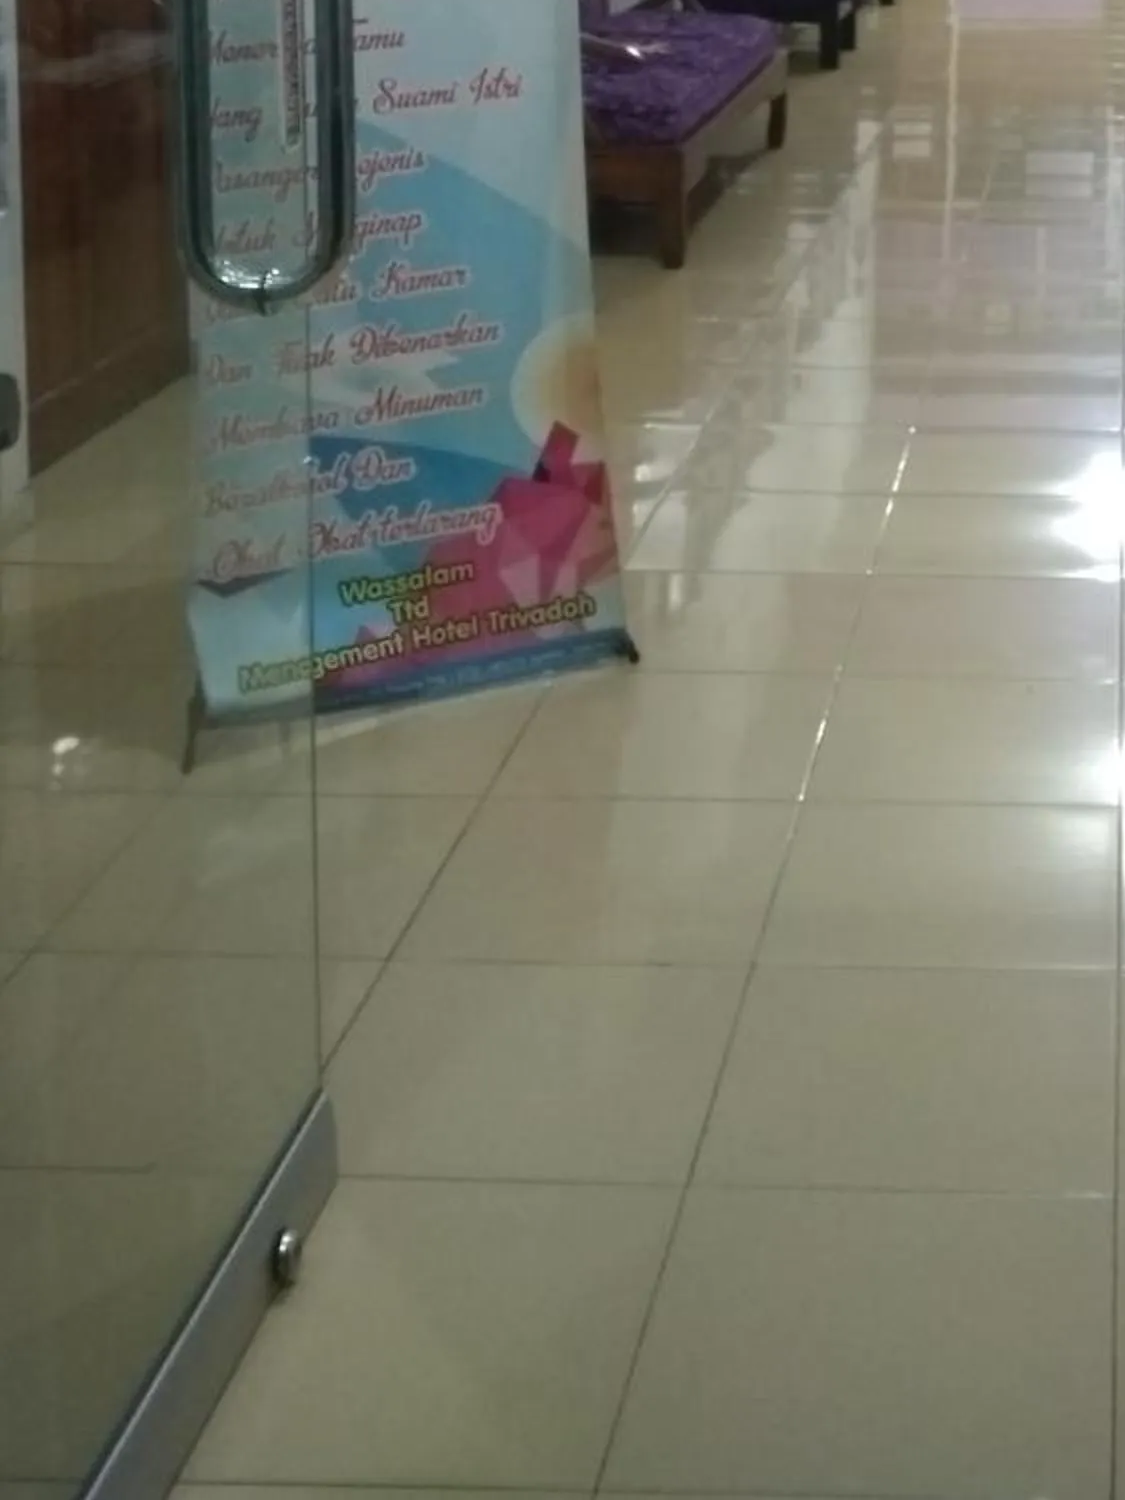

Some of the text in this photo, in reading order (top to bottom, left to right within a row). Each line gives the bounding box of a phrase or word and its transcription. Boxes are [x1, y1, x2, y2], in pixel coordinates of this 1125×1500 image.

[373, 77, 459, 116] Suami
[469, 67, 523, 105] Istri
[371, 261, 468, 298] Kamar
[350, 312, 500, 366] Dibenarkan
[354, 385, 484, 426] Minuman
[356, 450, 412, 487] Dan
[340, 562, 475, 601] Wassalam
[389, 594, 430, 623] Ttd
[413, 616, 479, 650] Hotel
[489, 592, 595, 633] Trivadoh
